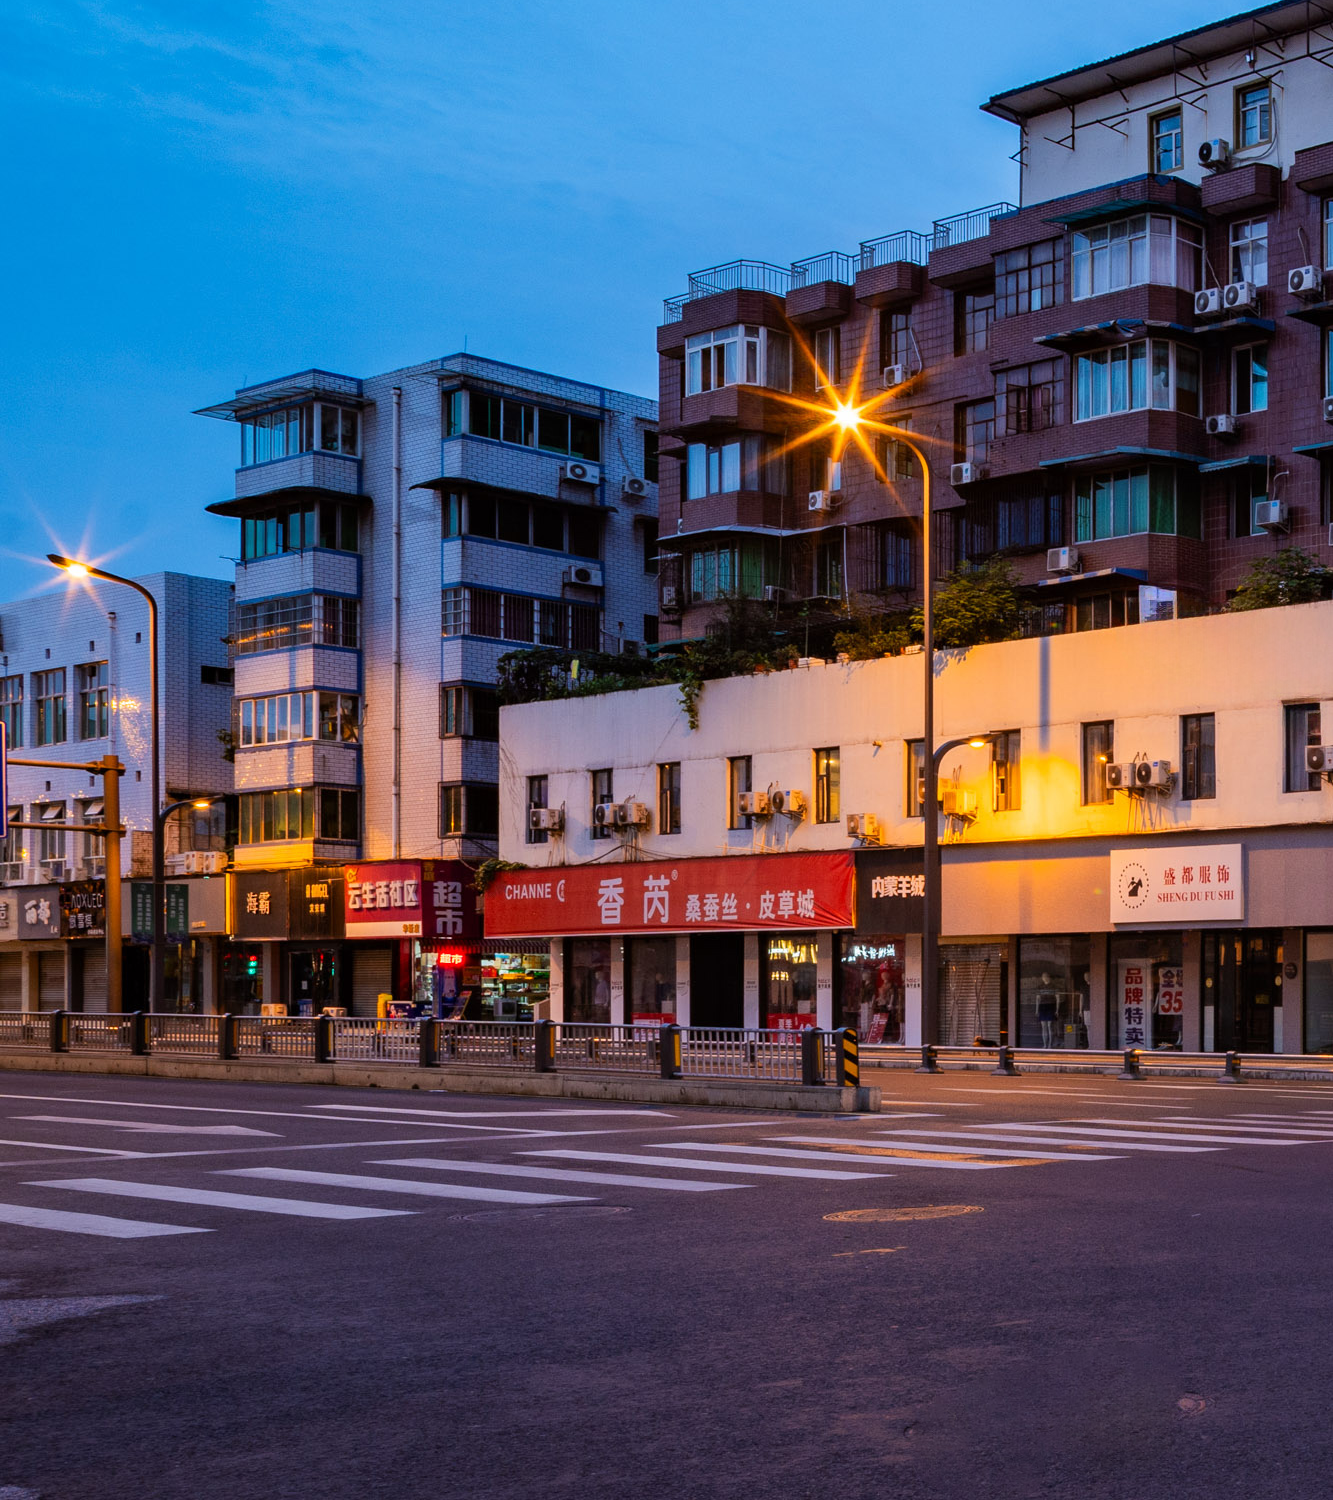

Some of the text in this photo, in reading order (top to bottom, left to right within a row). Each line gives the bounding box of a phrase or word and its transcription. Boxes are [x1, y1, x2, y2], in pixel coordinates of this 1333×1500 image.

[1164, 864, 1230, 885] 盛都服饰
[348, 879, 418, 909] 云生活社区
[505, 883, 552, 900] CHANNE
[871, 874, 926, 898] 内蒙羊绒
[1157, 890, 1234, 903] SHENG DU FU SHI
[433, 880, 463, 936] 超市
[440, 953, 463, 964] 超市
[1124, 968, 1144, 1045] 品牌特卖
